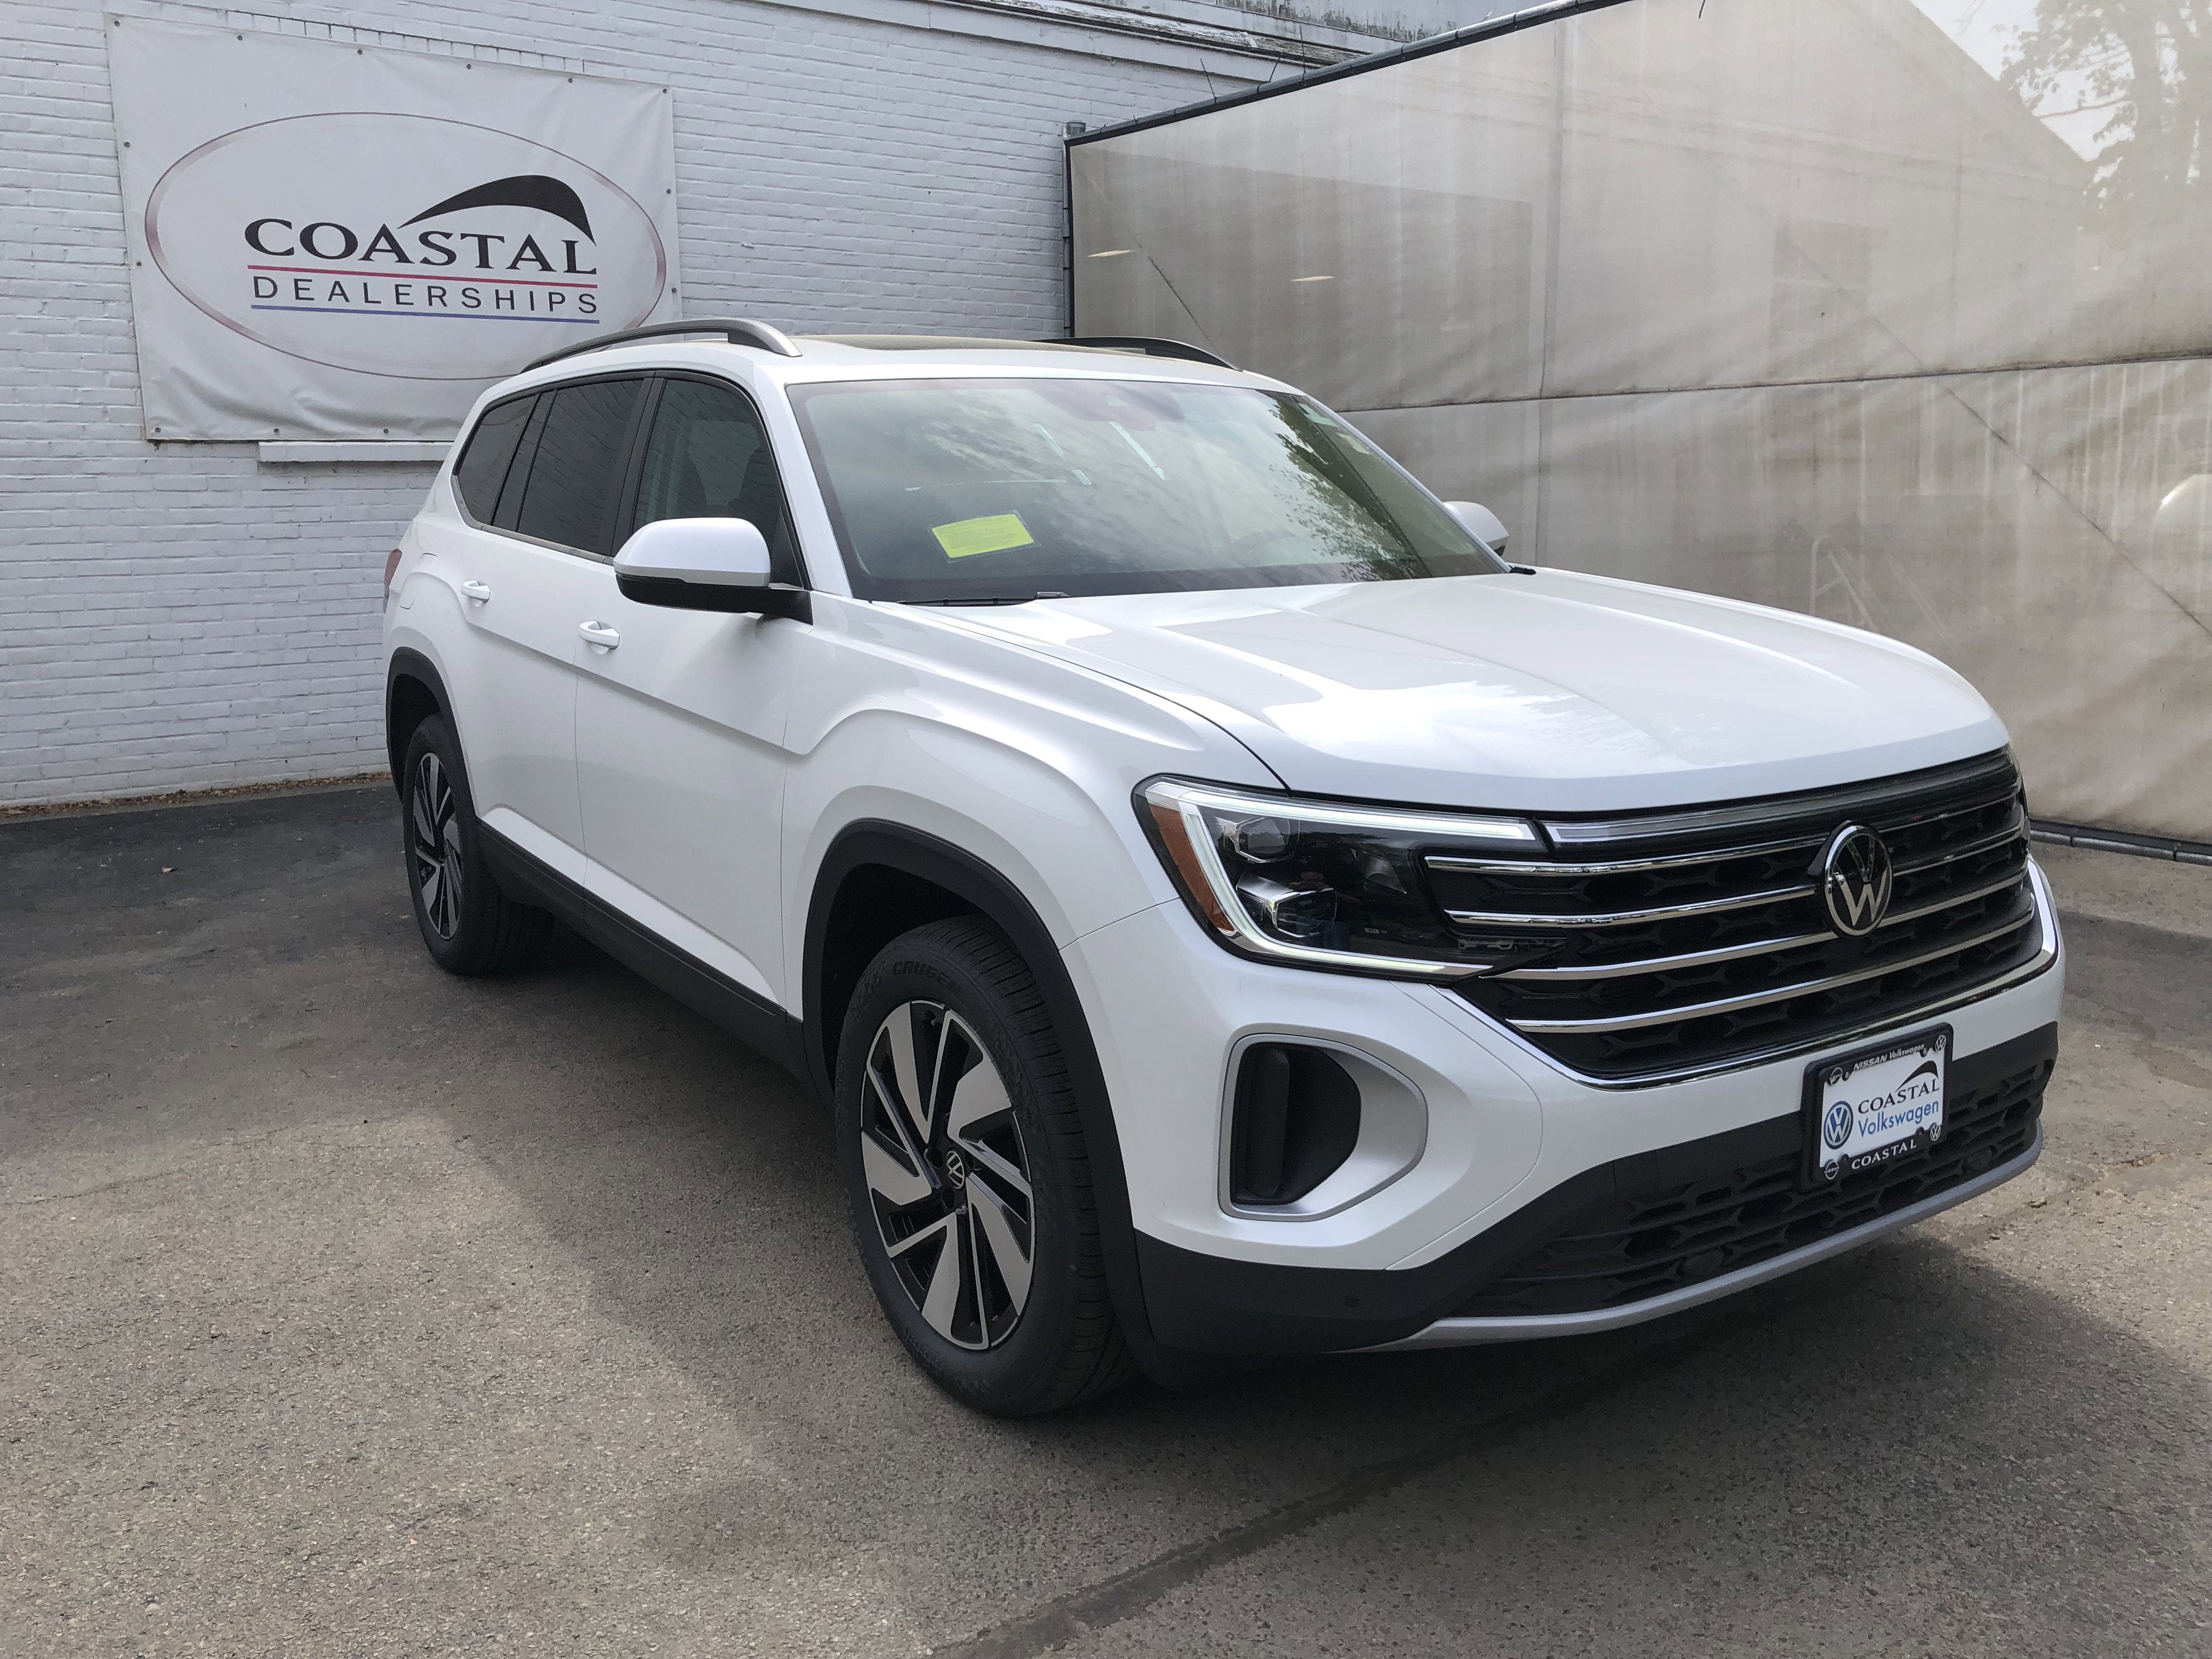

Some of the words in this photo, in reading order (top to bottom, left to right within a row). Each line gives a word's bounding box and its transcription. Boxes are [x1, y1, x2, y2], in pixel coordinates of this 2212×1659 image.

[245, 218, 597, 275] COASTAL
[253, 276, 597, 314] DEALERSHIPS
[1854, 1054, 1887, 1070] NISSAN
[1889, 1044, 1925, 1060] Volkswagen
[1858, 1079, 1940, 1114] COASTAL
[1824, 1102, 1853, 1148] VW
[1858, 1101, 1939, 1137] Volkswagen
[1852, 1139, 1917, 1170] COASTAL
